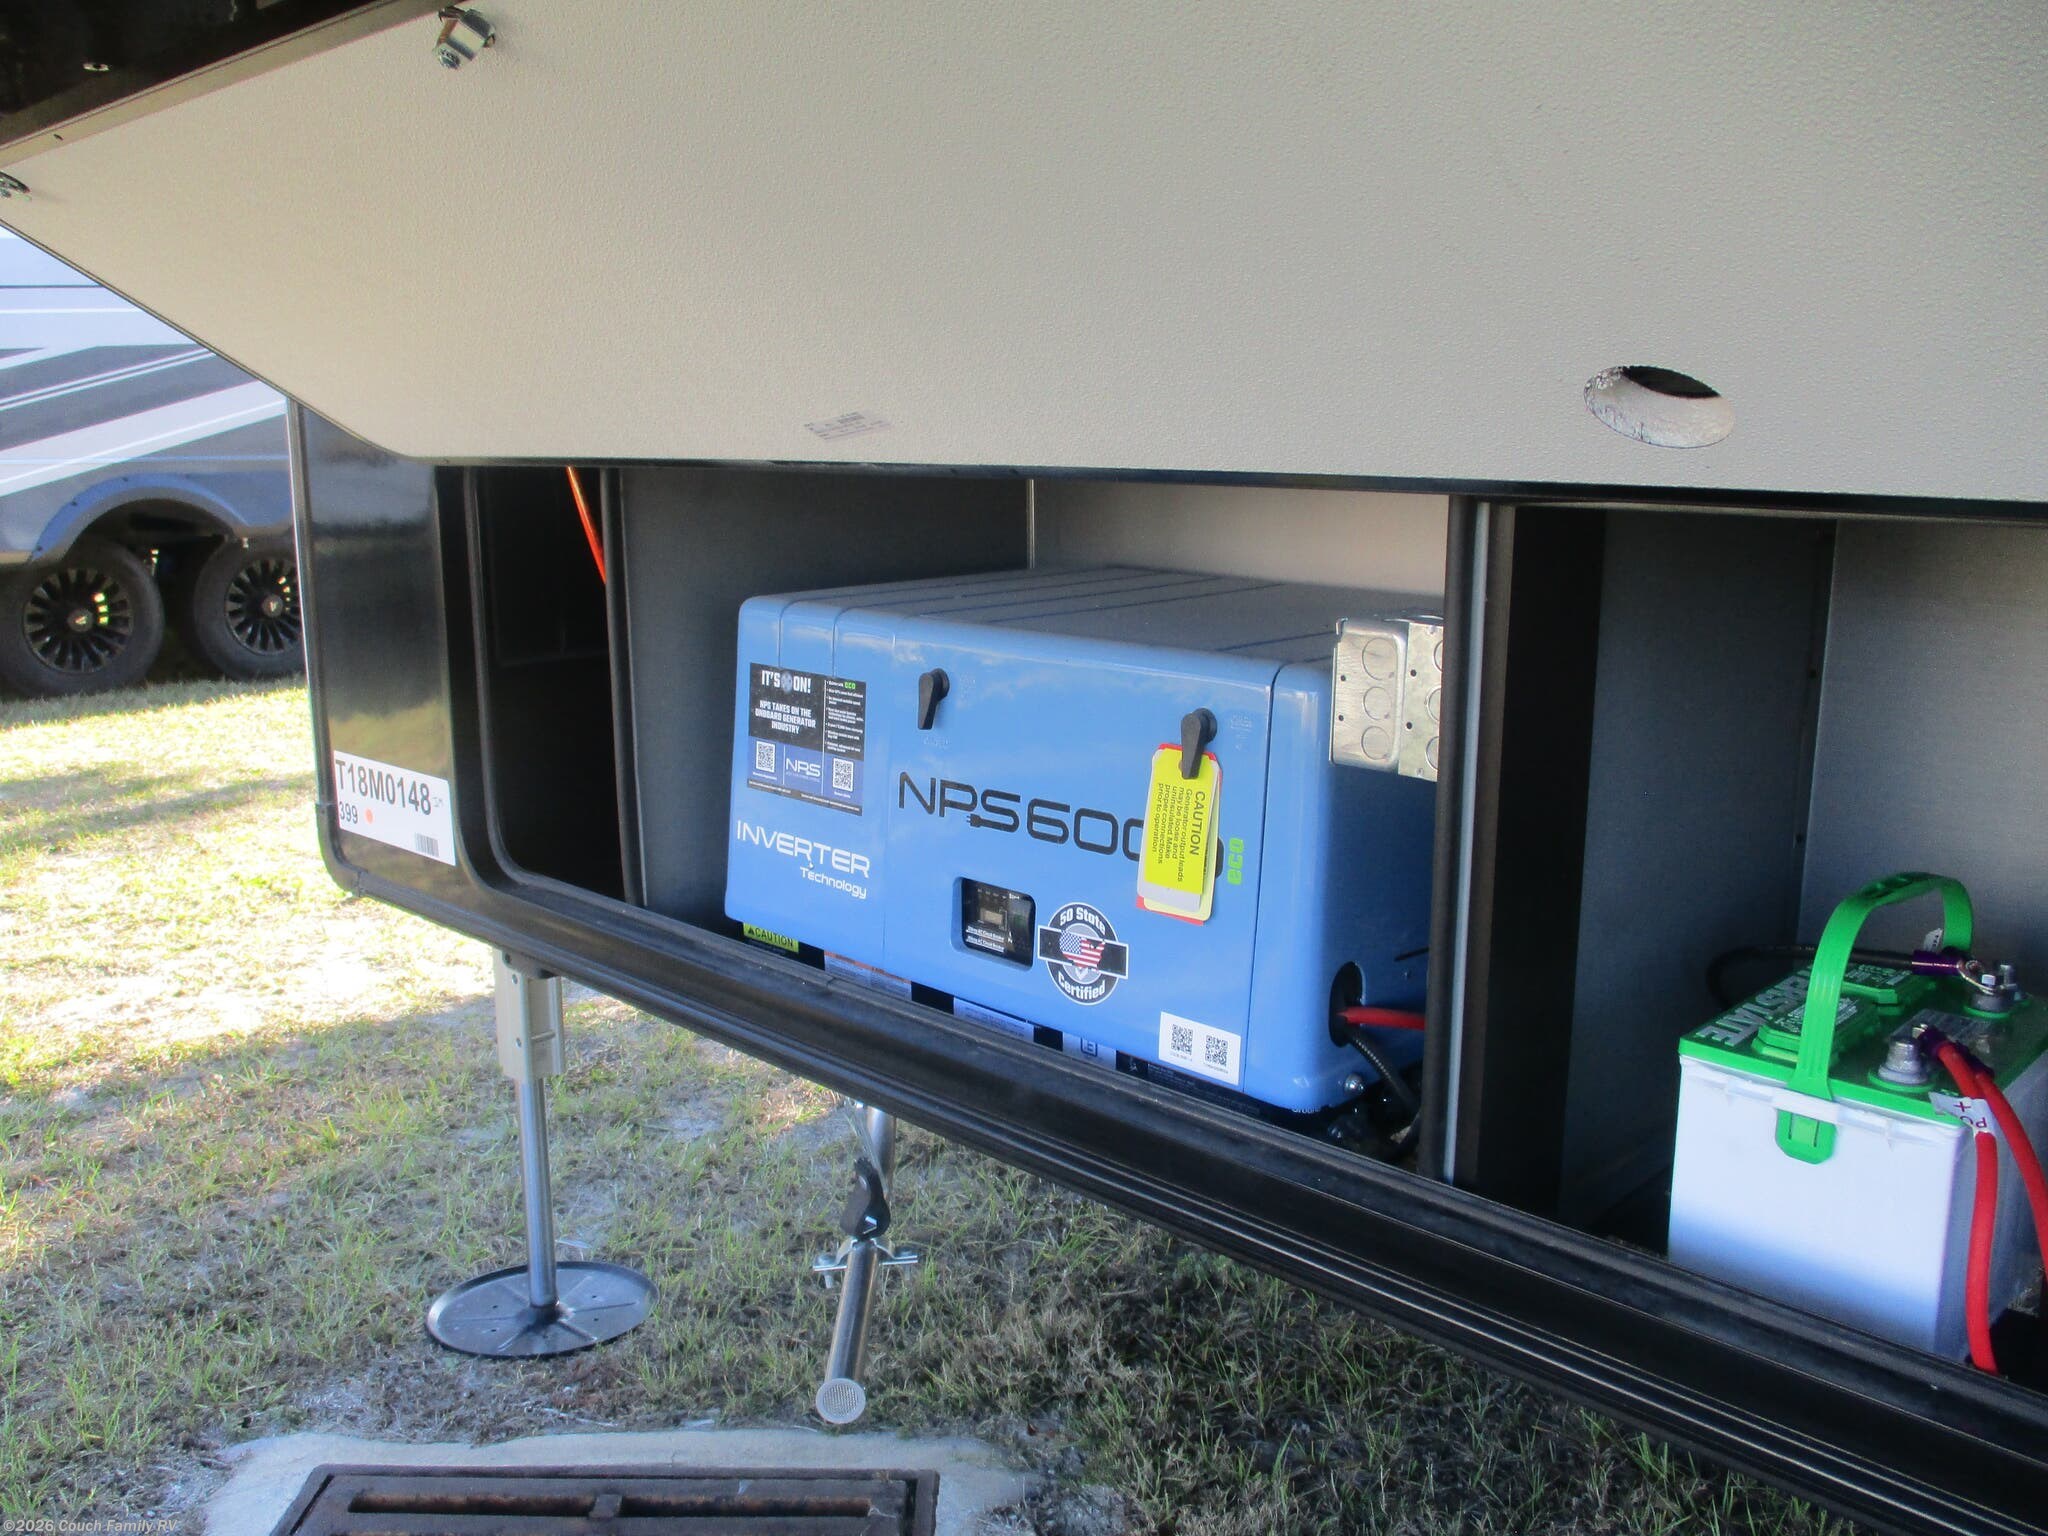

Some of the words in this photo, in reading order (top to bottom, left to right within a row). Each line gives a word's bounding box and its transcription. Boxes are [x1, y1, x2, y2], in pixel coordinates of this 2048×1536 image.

[761, 669, 781, 688] IT'S
[793, 675, 812, 694] ON!
[755, 708, 782, 721] ONBOARD
[782, 713, 816, 728] GENERATOR
[759, 699, 771, 710] NPS
[772, 701, 790, 713] TAKES
[790, 705, 800, 716] ON
[800, 707, 812, 718] THE
[771, 720, 800, 734] INDUSTRY
[785, 757, 821, 777] NPS
[335, 759, 432, 816] T18M0148
[339, 801, 359, 824] 399
[1156, 802, 1162, 812] to
[1176, 805, 1183, 817] be
[1182, 788, 1193, 831] Generator
[1189, 791, 1206, 856] CAUTION
[736, 819, 871, 878] INVERTER
[1157, 813, 1167, 864] connections
[1165, 836, 1173, 859] Make
[1179, 831, 1187, 858] output
[1171, 842, 1179, 860] and
[1177, 858, 1185, 882] leads
[799, 866, 867, 900] Technology
[1059, 908, 1074, 926] 50
[1076, 906, 1106, 936] State
[755, 927, 793, 947] CAUTION
[1057, 970, 1106, 1000] Certified
